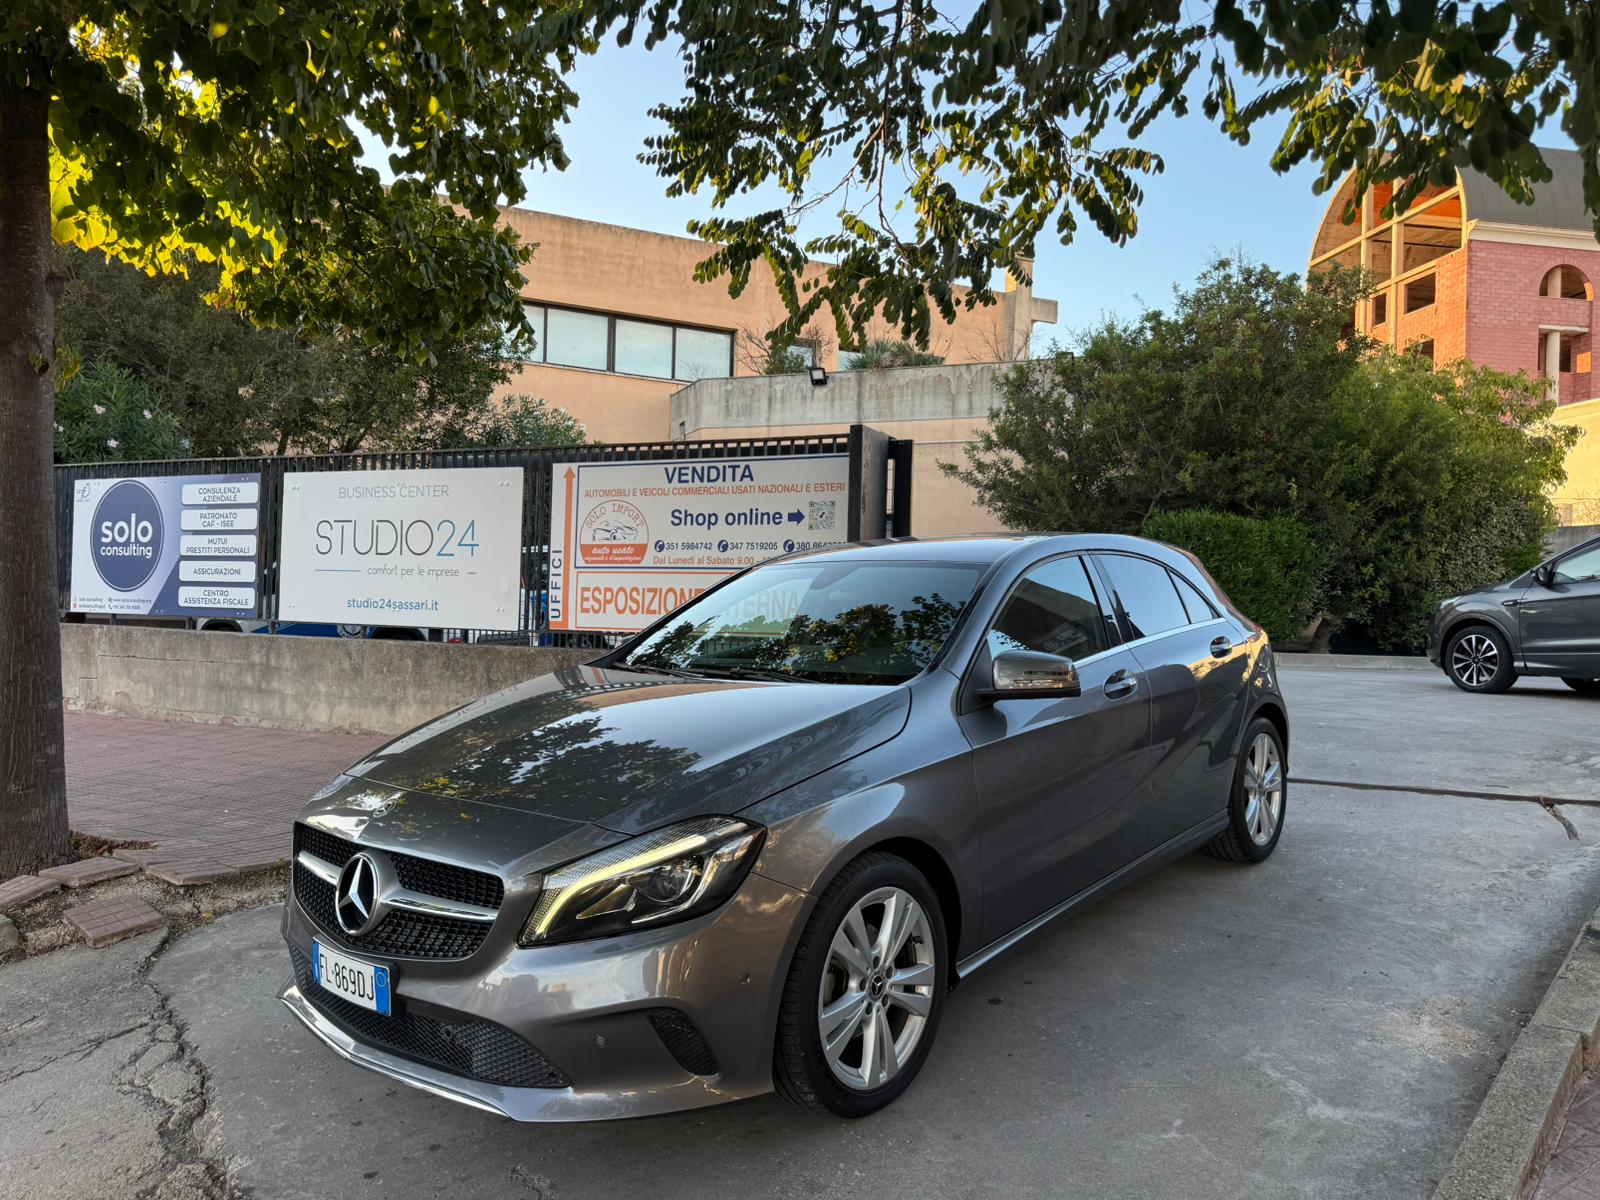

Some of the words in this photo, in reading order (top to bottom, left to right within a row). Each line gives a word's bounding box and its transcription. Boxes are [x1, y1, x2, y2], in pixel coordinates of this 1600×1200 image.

[664, 464, 754, 484] VENDITA
[198, 487, 241, 495] CONSULENZA
[339, 485, 397, 499] BUSINESS
[399, 484, 450, 498] CENTER
[584, 488, 631, 498] AUTOMOBILI
[632, 488, 638, 497] E
[639, 487, 670, 497] VEICOLI
[671, 485, 730, 496] COMMERCIALI
[731, 484, 755, 495] USATI
[757, 483, 804, 494] NAZIONALI
[805, 483, 811, 492] E
[813, 482, 846, 492] ESTERI
[202, 494, 238, 502] AZIENDALE
[199, 512, 238, 521] PATRONATO
[585, 506, 607, 529] SOLO
[611, 503, 645, 529] IMPORT
[671, 508, 719, 530] Shop
[725, 508, 783, 526] online
[101, 512, 153, 544] solo
[202, 520, 215, 528] CAF
[220, 520, 235, 528] ISEE
[316, 519, 479, 557] STUDIO24
[665, 542, 679, 551] 351
[681, 541, 713, 550] 5984742
[729, 541, 743, 550] 347
[745, 541, 778, 550] 7519205
[795, 541, 811, 551] 380
[100, 543, 153, 559] consulting
[186, 547, 213, 555] PRESTITI
[213, 547, 250, 555] PERSONALI
[653, 555, 666, 565] Dal
[697, 555, 705, 565] al
[706, 555, 735, 565] Sabato
[193, 568, 241, 576] ASSICURAZIONI
[367, 563, 398, 576] comfort
[401, 566, 415, 580] per
[417, 565, 426, 576] le
[427, 565, 460, 580] imprese
[550, 549, 563, 619] UFFICI
[203, 589, 229, 597] CENTRO
[184, 597, 222, 605] ASSISTENZA
[222, 598, 249, 606] FISCALE
[347, 598, 440, 612] studio24sassari.it
